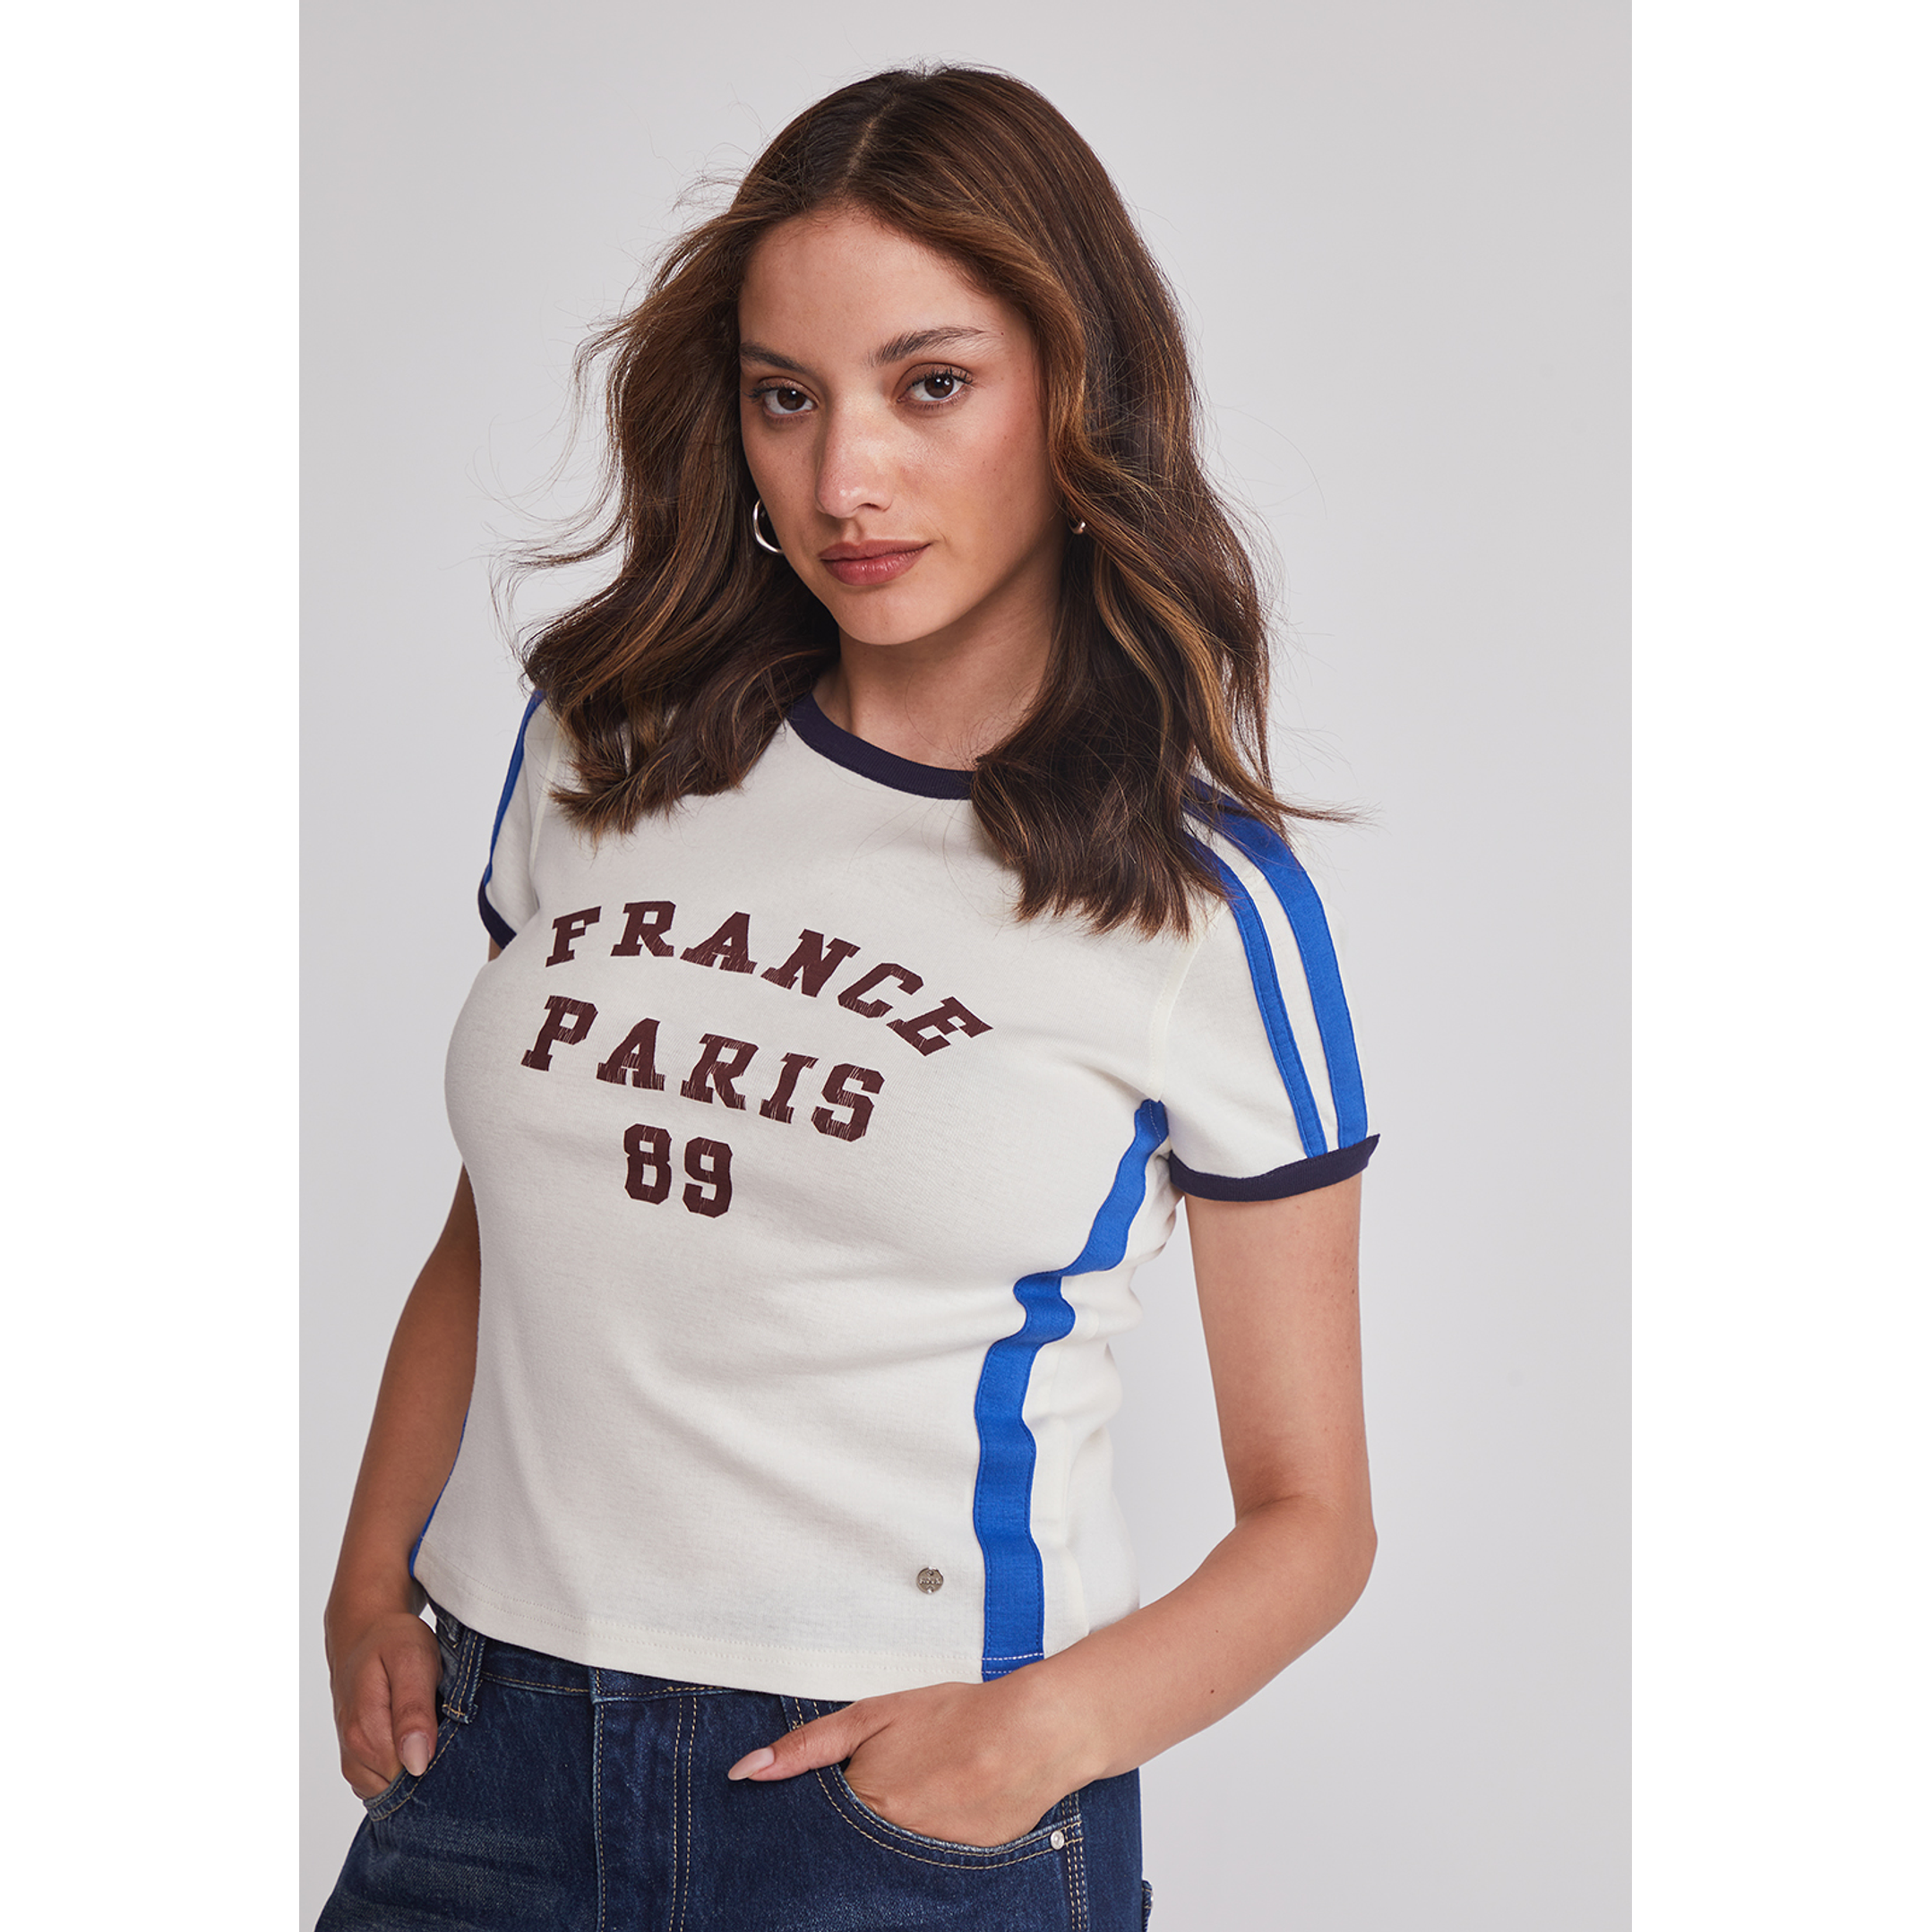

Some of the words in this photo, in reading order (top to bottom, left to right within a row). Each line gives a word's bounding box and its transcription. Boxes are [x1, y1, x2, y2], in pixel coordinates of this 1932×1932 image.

[545, 900, 993, 1057] FRANCE
[520, 995, 885, 1142] PARIS
[623, 1123, 733, 1218] 89
